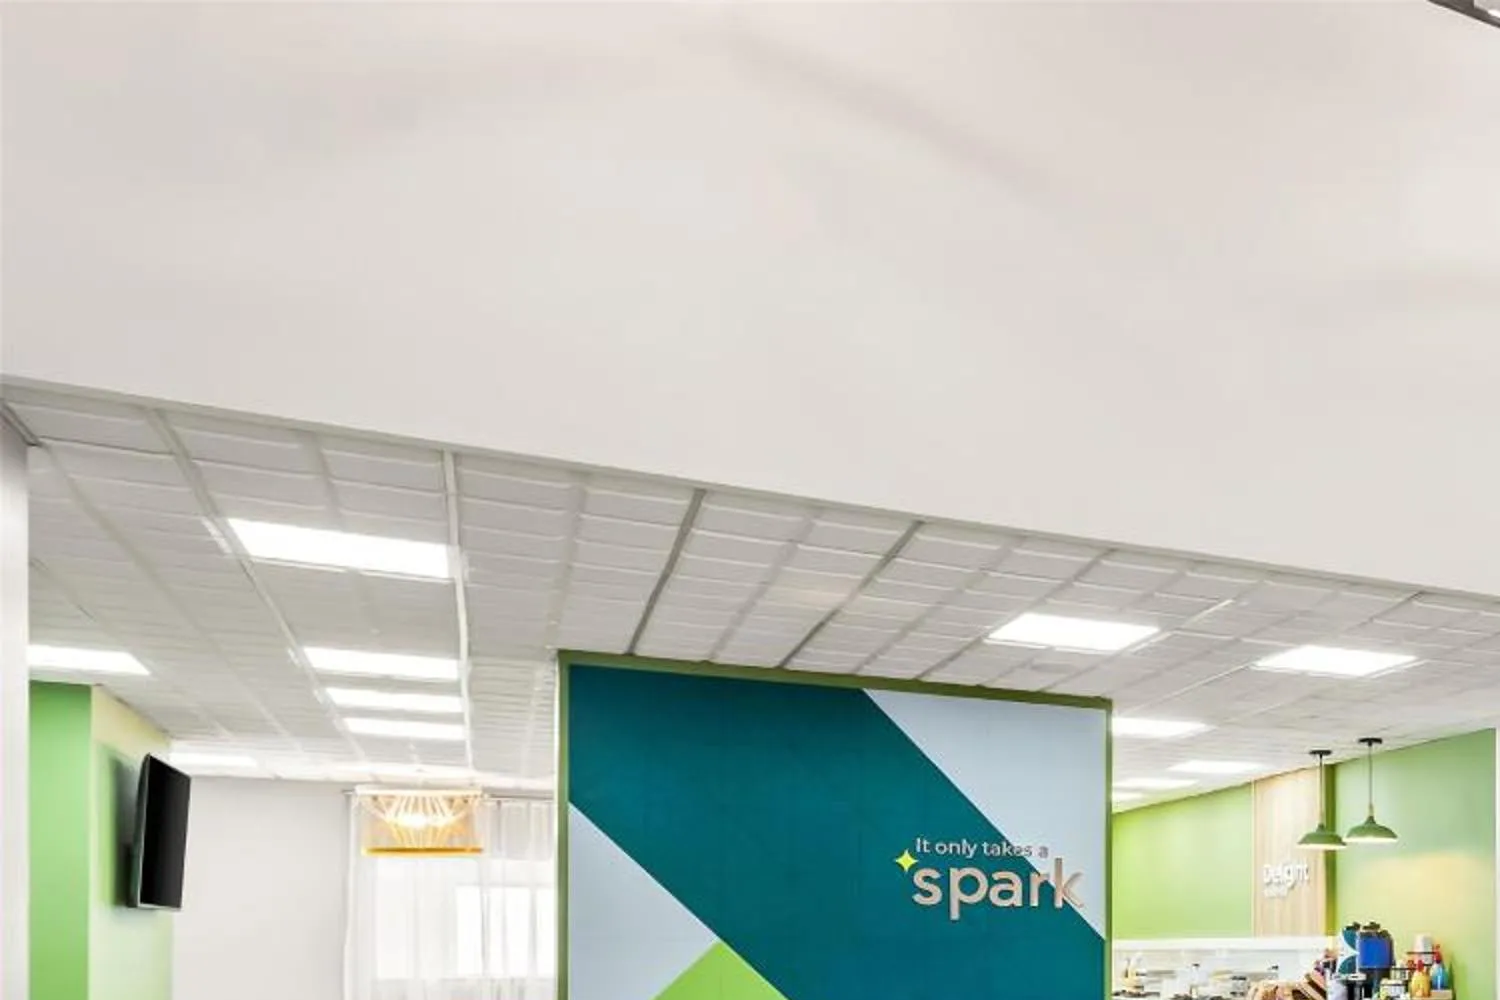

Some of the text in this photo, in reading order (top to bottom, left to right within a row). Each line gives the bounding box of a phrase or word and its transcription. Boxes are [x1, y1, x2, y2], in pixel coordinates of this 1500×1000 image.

[915, 837, 1050, 859] It only takes a
[911, 857, 1085, 921] spark
